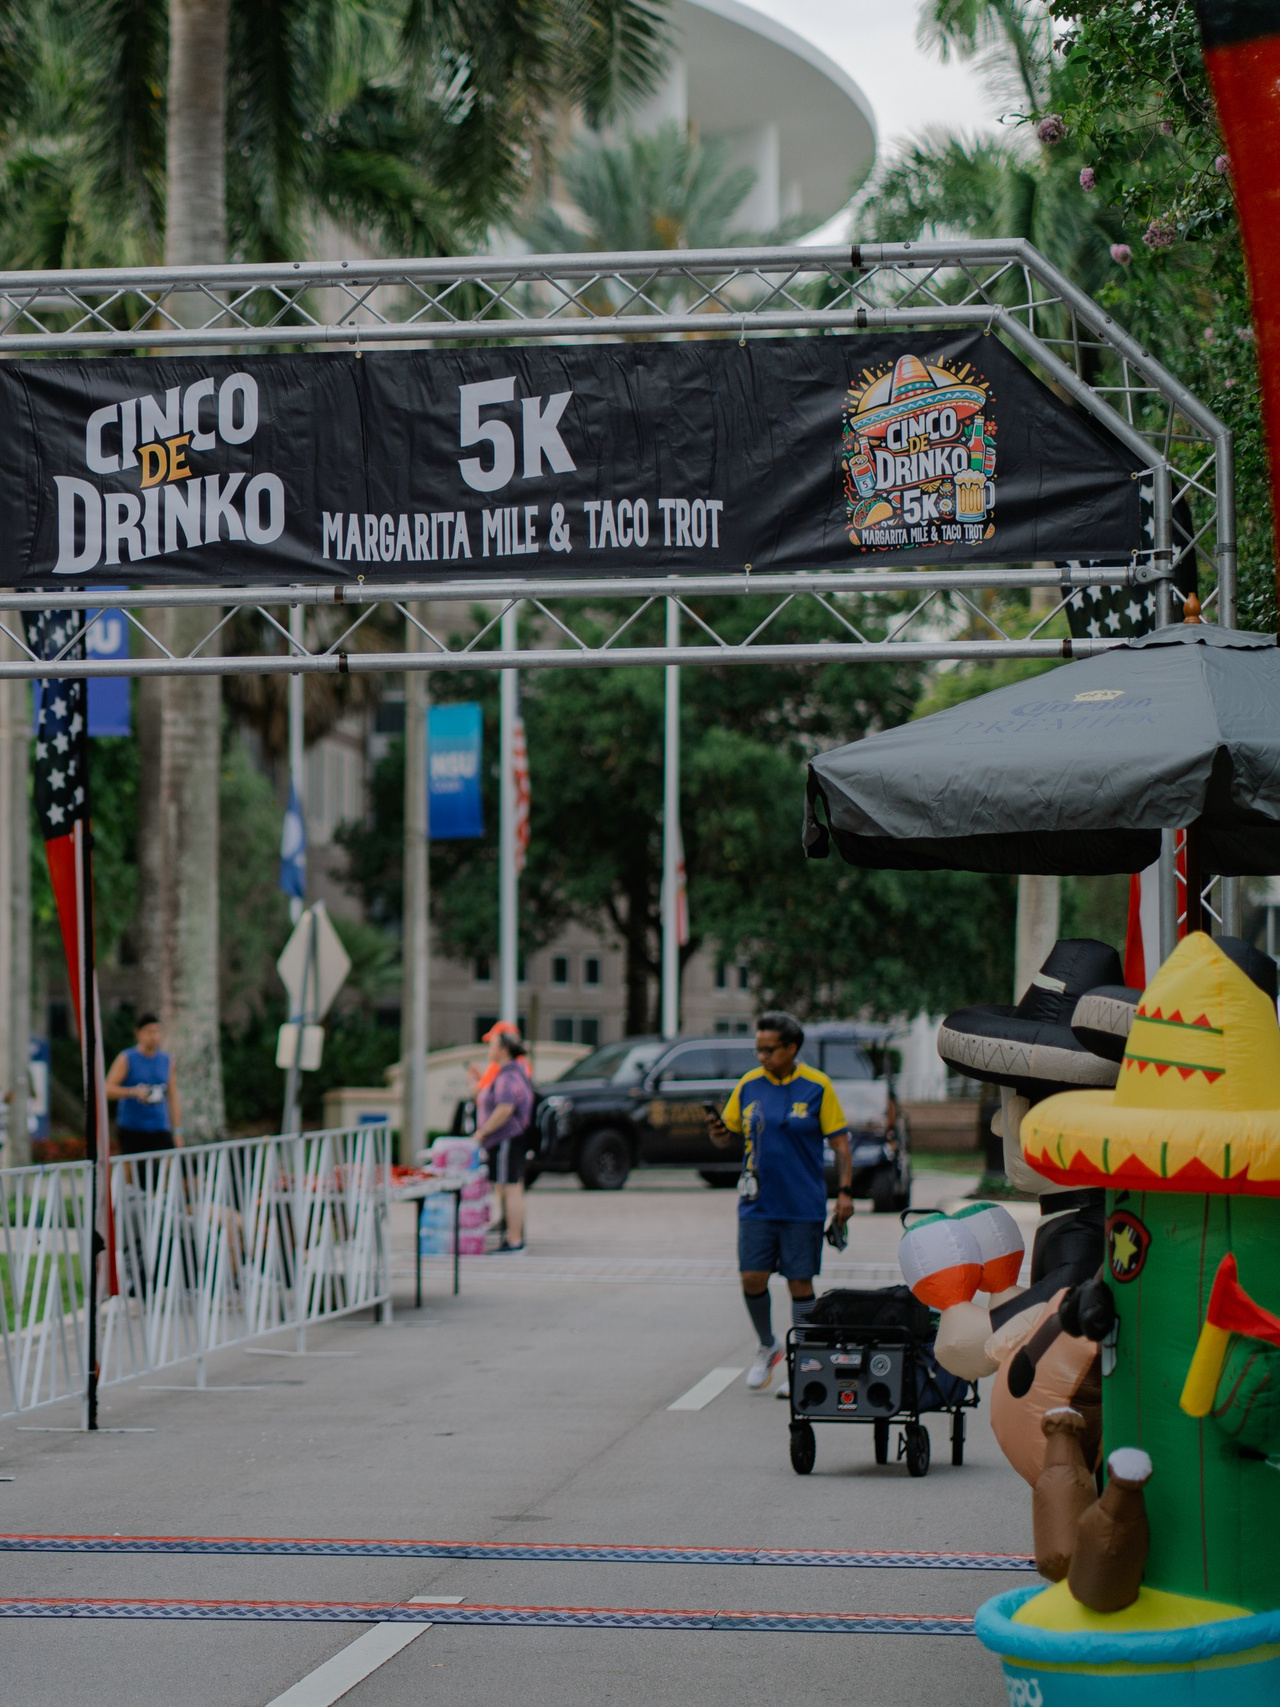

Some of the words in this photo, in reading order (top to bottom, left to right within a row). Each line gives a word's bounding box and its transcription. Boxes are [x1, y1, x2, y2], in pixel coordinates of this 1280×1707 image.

[86, 372, 258, 474] CINCO
[458, 375, 577, 492] 5K
[886, 408, 957, 449] CINCO
[138, 434, 192, 488] DE
[908, 434, 930, 454] DE
[874, 447, 968, 489] DRINKO
[52, 472, 285, 574] DRINKO
[903, 489, 939, 524] 5K
[322, 511, 472, 562] MARGARITA
[482, 505, 539, 557] MILE
[549, 502, 573, 553] &
[584, 498, 649, 549] TACO
[659, 498, 723, 548] TROT
[862, 528, 907, 544] MARGARITA
[910, 527, 928, 542] MILE
[931, 528, 938, 541] &
[941, 525, 961, 539] TACO
[964, 525, 984, 539] TROT
[951, 711, 1156, 735] PREMIER
[1010, 697, 1152, 718] Corona
